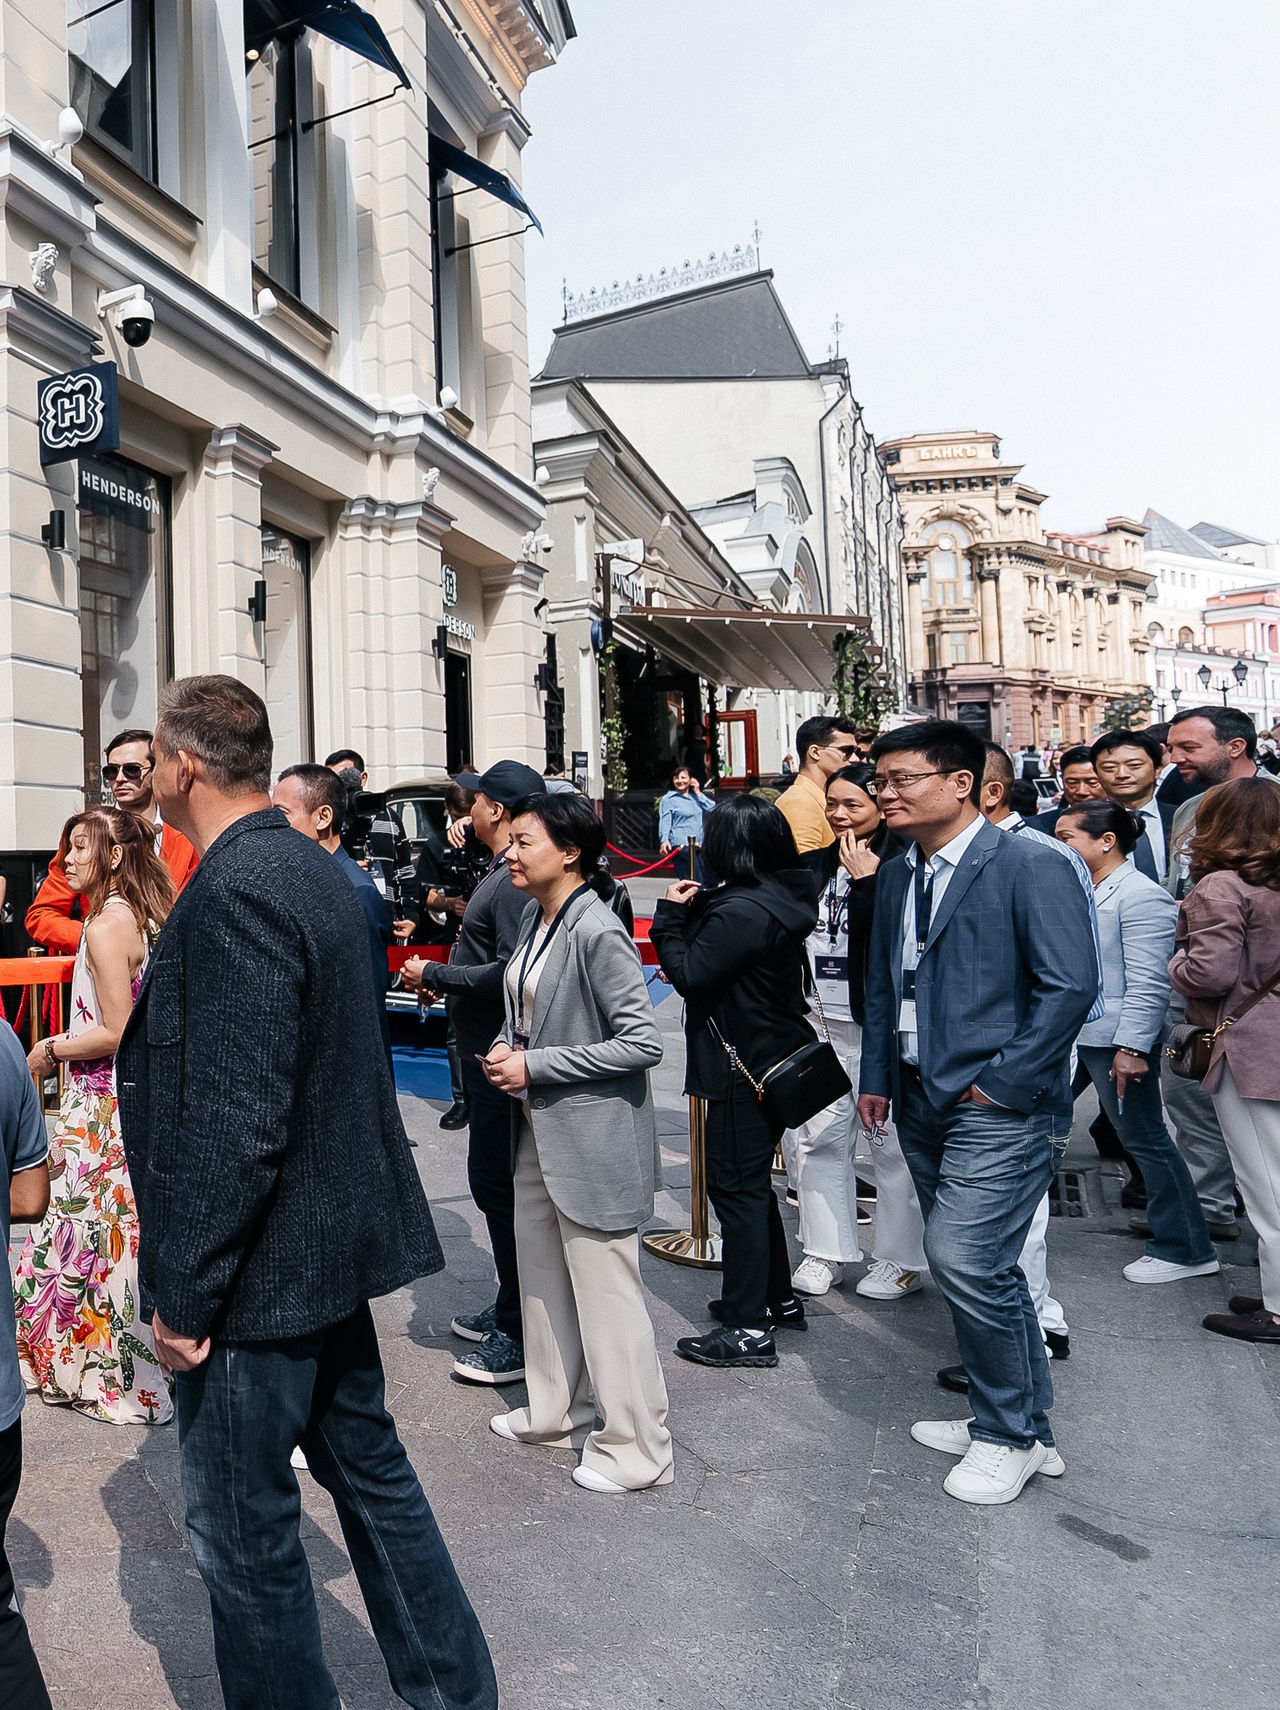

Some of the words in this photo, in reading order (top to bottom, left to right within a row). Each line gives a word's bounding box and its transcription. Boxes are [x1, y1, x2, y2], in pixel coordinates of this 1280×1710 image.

[57, 393, 86, 428] H
[919, 445, 977, 461] БАНКЪ
[82, 470, 160, 515] HENDERSON
[263, 545, 302, 573] NDERSON
[443, 612, 476, 639] DERSON
